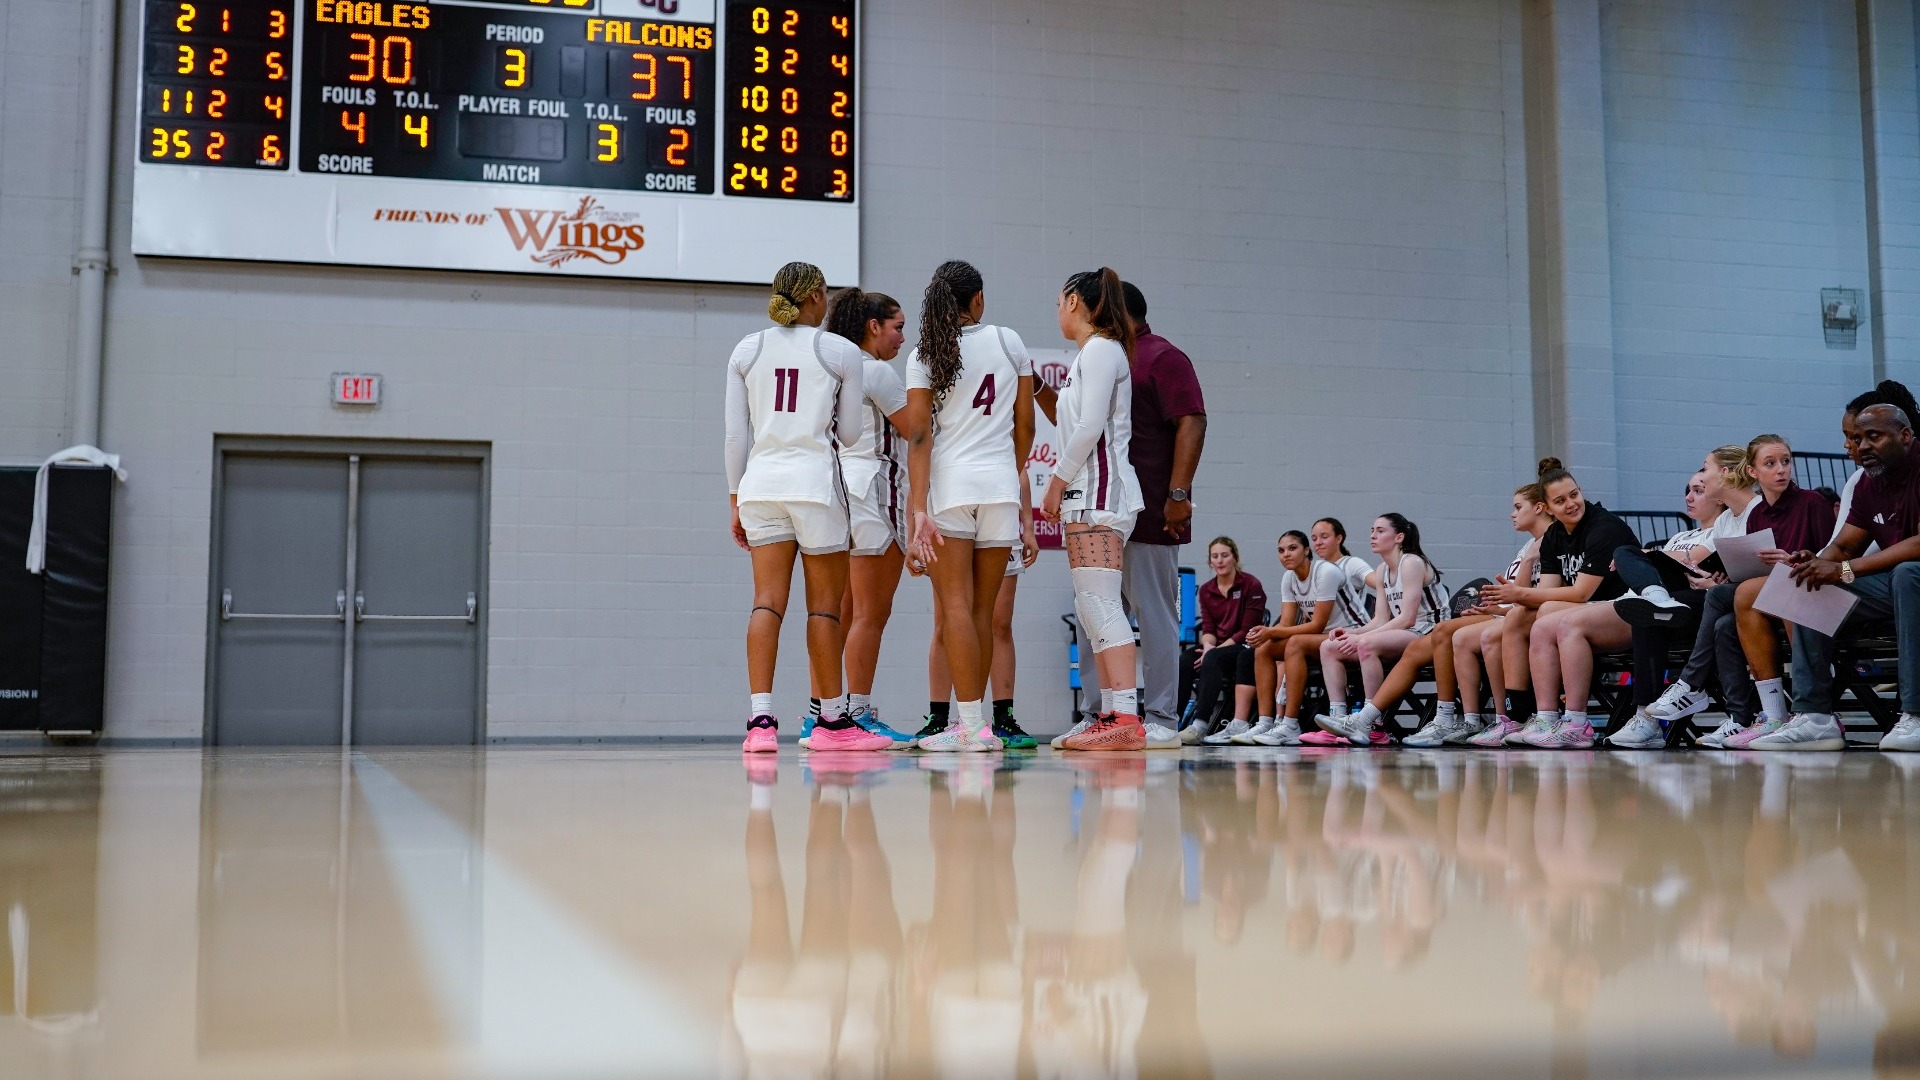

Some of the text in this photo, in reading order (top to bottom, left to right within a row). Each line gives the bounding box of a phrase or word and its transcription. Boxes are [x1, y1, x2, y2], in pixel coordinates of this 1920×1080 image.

[176, 3, 196, 32] 2
[269, 10, 285, 38] 3
[316, 0, 431, 29] EAGLES
[782, 9, 799, 36] 2
[486, 23, 545, 44] PERIOD
[586, 18, 713, 50] FALCONS
[177, 45, 284, 80] 3 2 5
[349, 33, 412, 84] 30
[504, 48, 526, 87] 3
[754, 46, 848, 77] 3 2 4
[632, 52, 691, 100] 37
[163, 88, 283, 119] 11 2 4
[322, 86, 377, 106] FOULS
[393, 90, 440, 110] T.O.L.
[458, 95, 570, 118] PLAYER FOUL
[741, 85, 769, 113] 10
[830, 91, 848, 118] 2
[341, 110, 366, 144] 4
[584, 103, 628, 122] T.O.L.
[645, 106, 697, 126] FOULS
[152, 127, 281, 163] 35 2 6
[404, 114, 428, 148] 4
[597, 123, 619, 162] 3
[666, 128, 689, 165] 2
[741, 124, 769, 153] 12
[318, 154, 373, 174] SCORE
[482, 163, 541, 184] MATCH
[730, 162, 847, 195] 24 2 3
[645, 173, 697, 192] SCORE
[373, 207, 645, 264] FRIENDS OF Wings
[342, 377, 374, 400] EXIT
[774, 368, 799, 413] 11
[972, 373, 996, 416] 4
